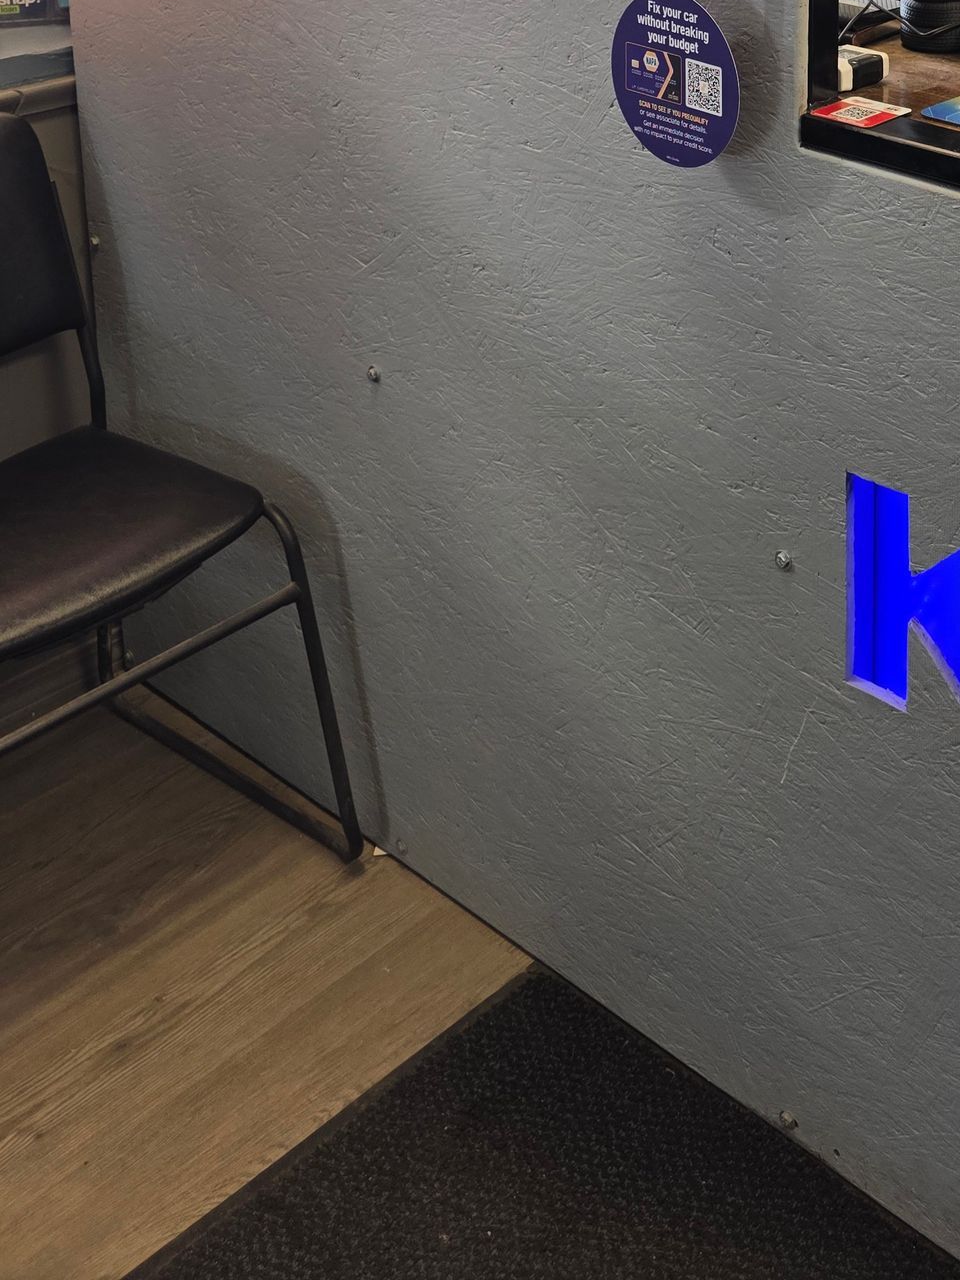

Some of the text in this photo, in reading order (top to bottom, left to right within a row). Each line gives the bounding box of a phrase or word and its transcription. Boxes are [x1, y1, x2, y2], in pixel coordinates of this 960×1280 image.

[647, 0, 698, 23] Fix your car
[637, 13, 709, 44] without breaking
[648, 31, 699, 55] your budget
[639, 99, 709, 126] SCAN PREQUALIFY
[656, 113, 680, 127] associate
[651, 130, 667, 142] impact
[659, 124, 704, 143] immediate decision
